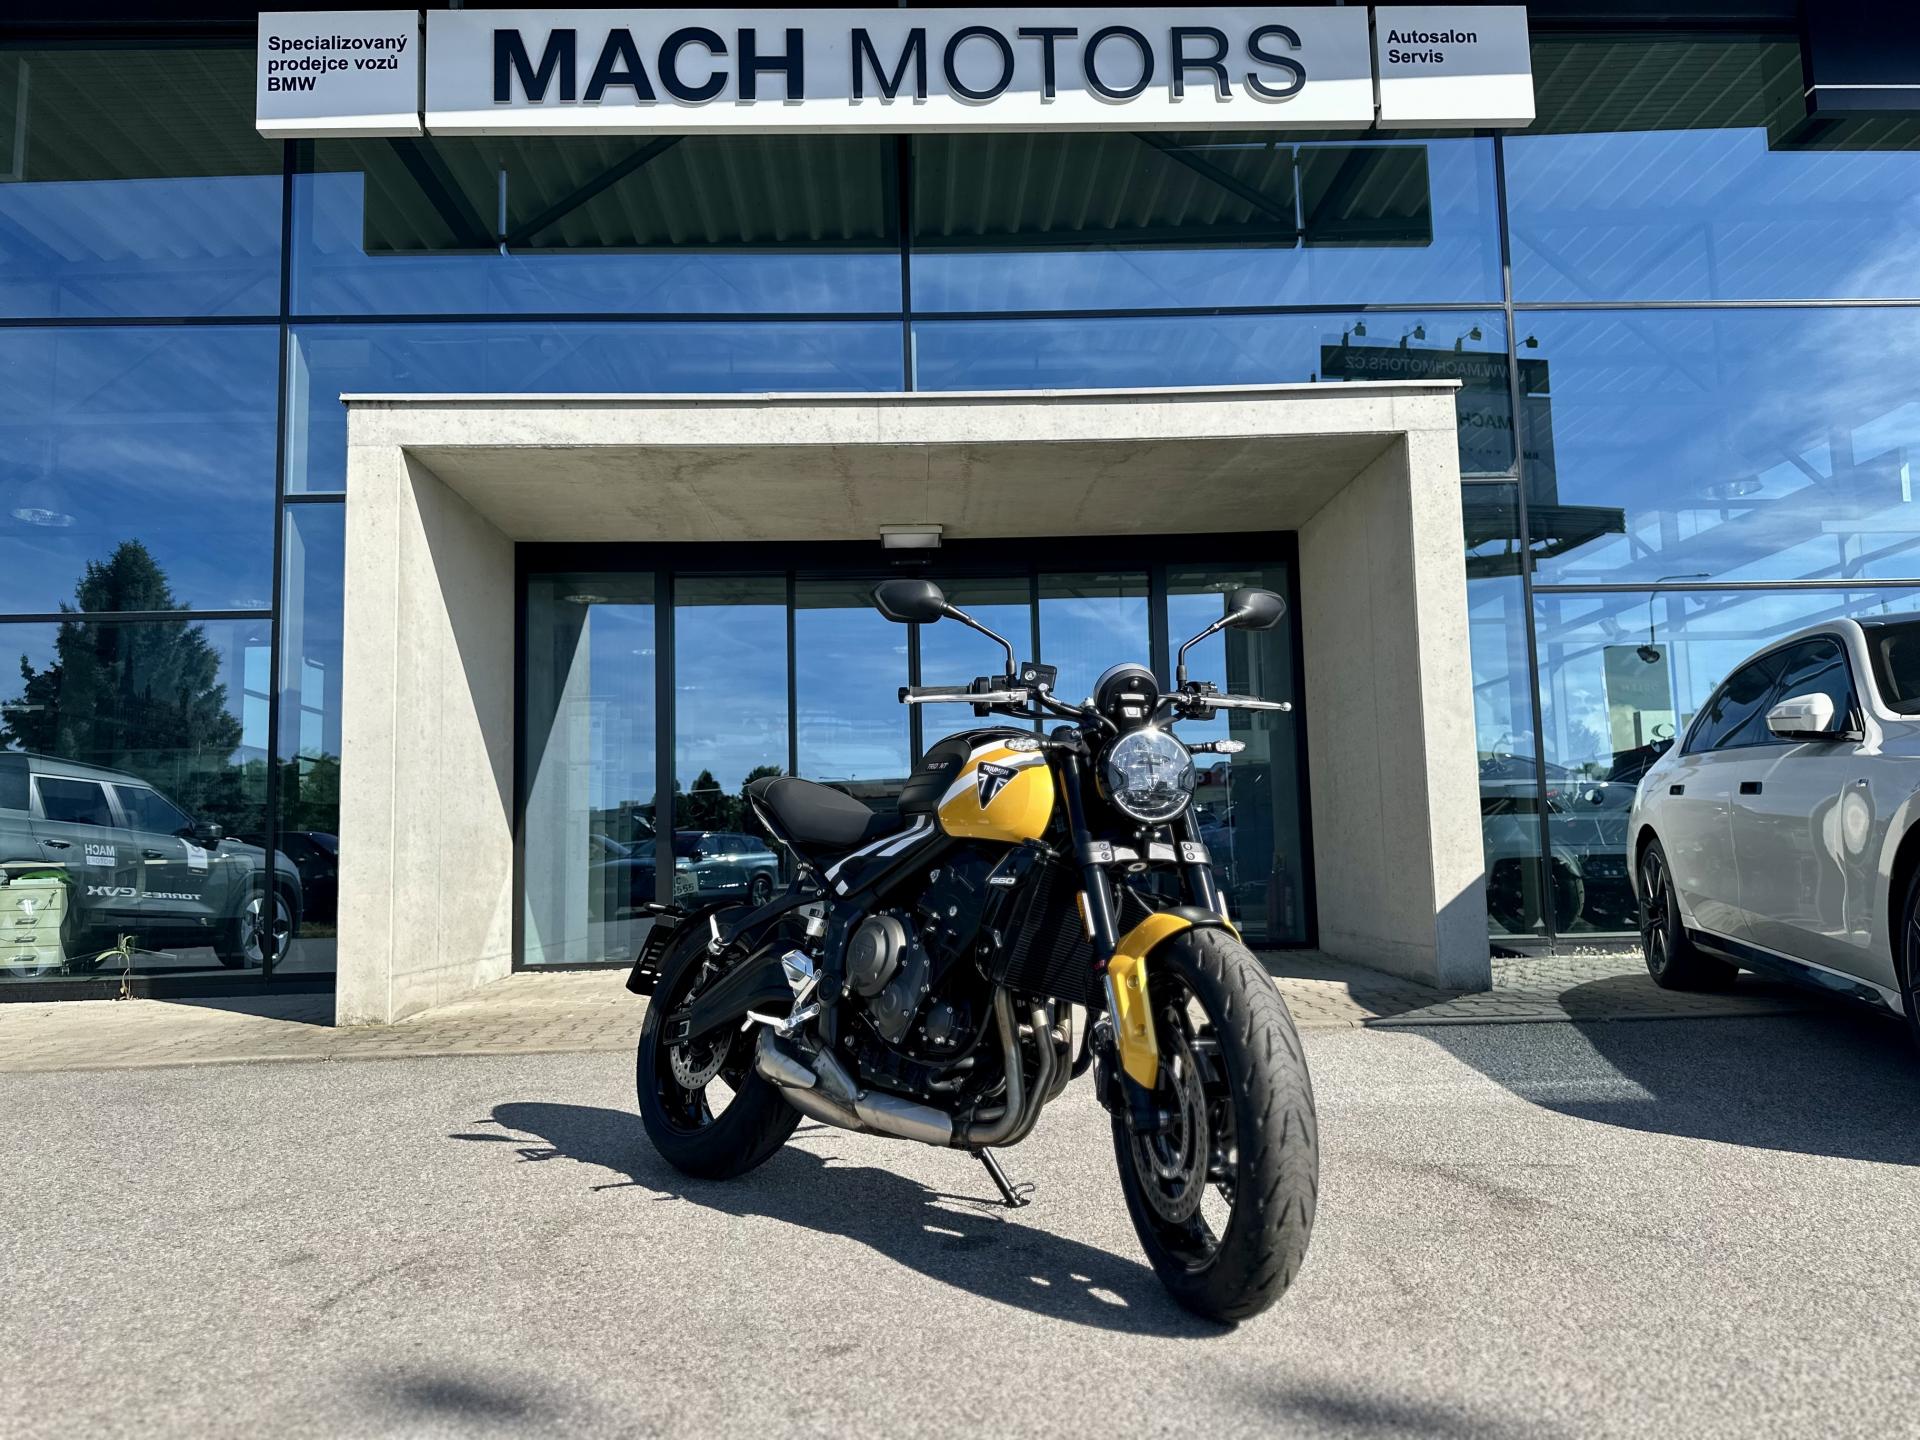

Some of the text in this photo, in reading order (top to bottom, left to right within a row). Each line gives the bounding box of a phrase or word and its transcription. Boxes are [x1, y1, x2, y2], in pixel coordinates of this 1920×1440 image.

[1387, 29, 1477, 43] Autosalon
[268, 34, 407, 53] Specializovaný
[1388, 49, 1444, 63] Servis
[268, 54, 398, 74] prodejce vozů
[492, 24, 1307, 104] MACH MOTORS
[267, 77, 316, 91] BMW
[983, 764, 1009, 775] TRIUMPH
[989, 877, 1016, 885] 660
